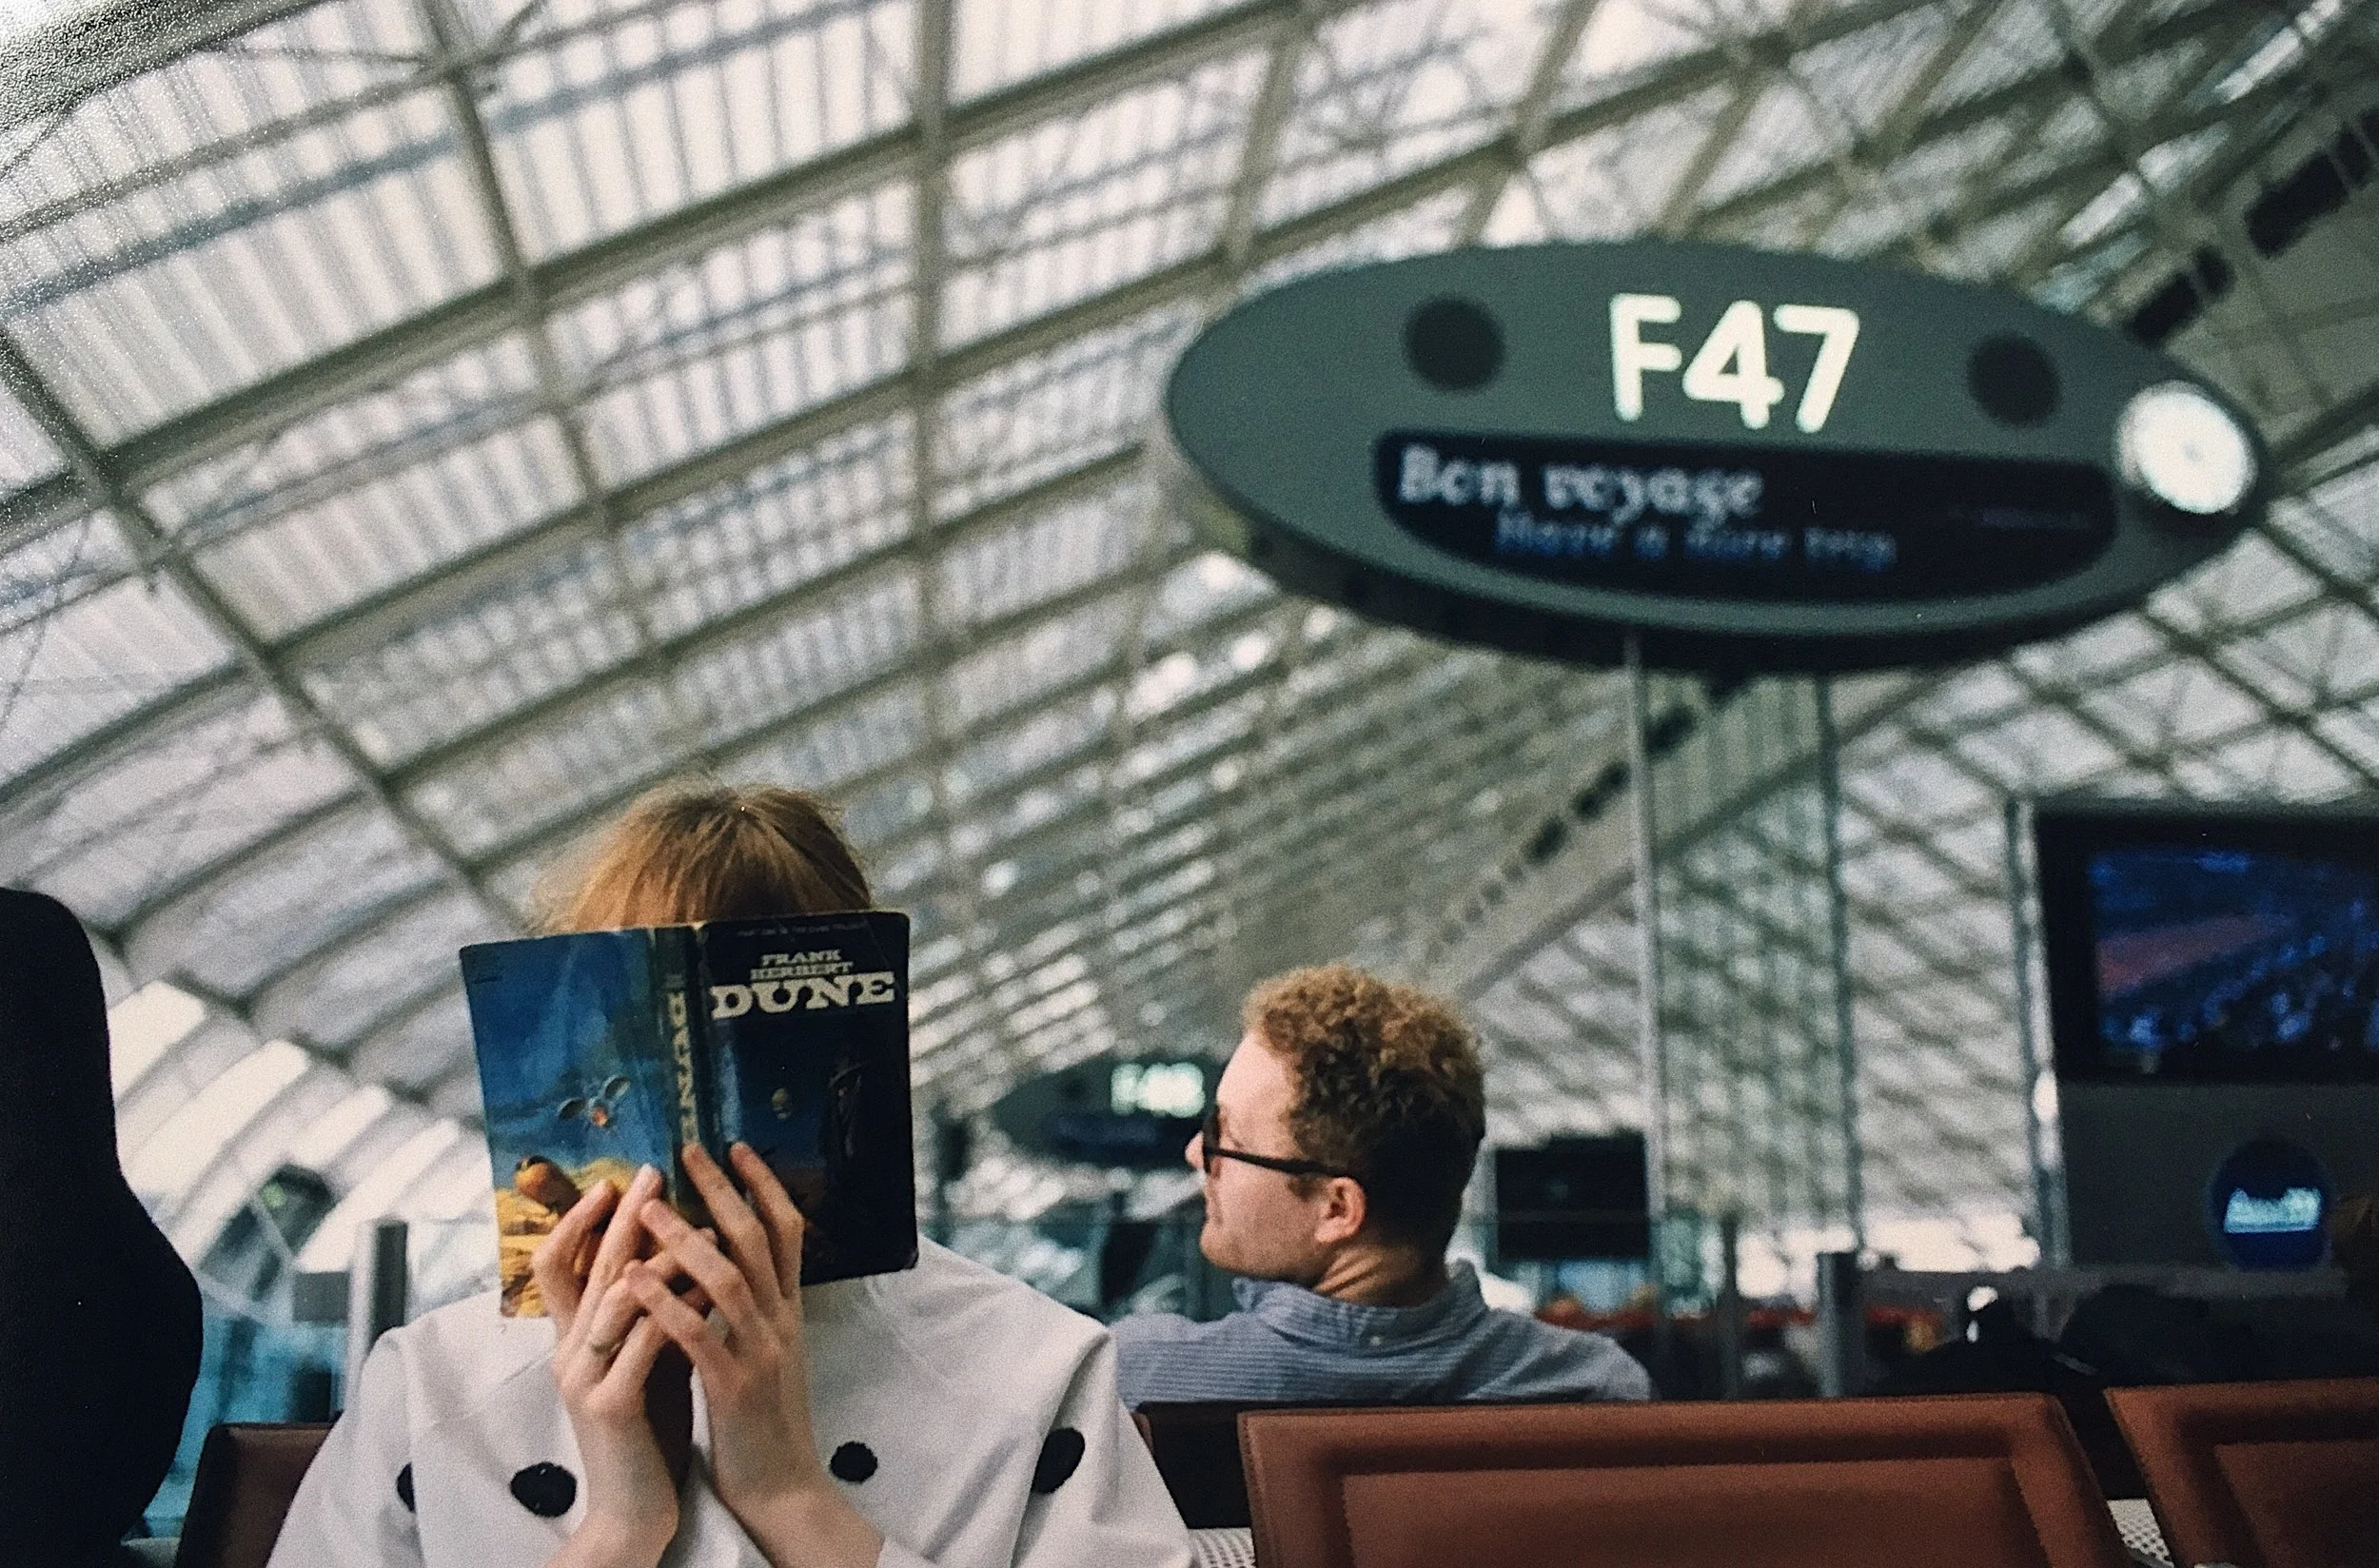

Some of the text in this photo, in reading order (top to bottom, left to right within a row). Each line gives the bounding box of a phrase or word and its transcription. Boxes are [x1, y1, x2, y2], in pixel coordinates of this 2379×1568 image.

[1609, 292, 1860, 434] F47
[1400, 443, 1764, 529] Bon voyage
[750, 961, 855, 982] HERBERT
[761, 949, 842, 969] FRANK
[709, 971, 895, 1021] DUNE
